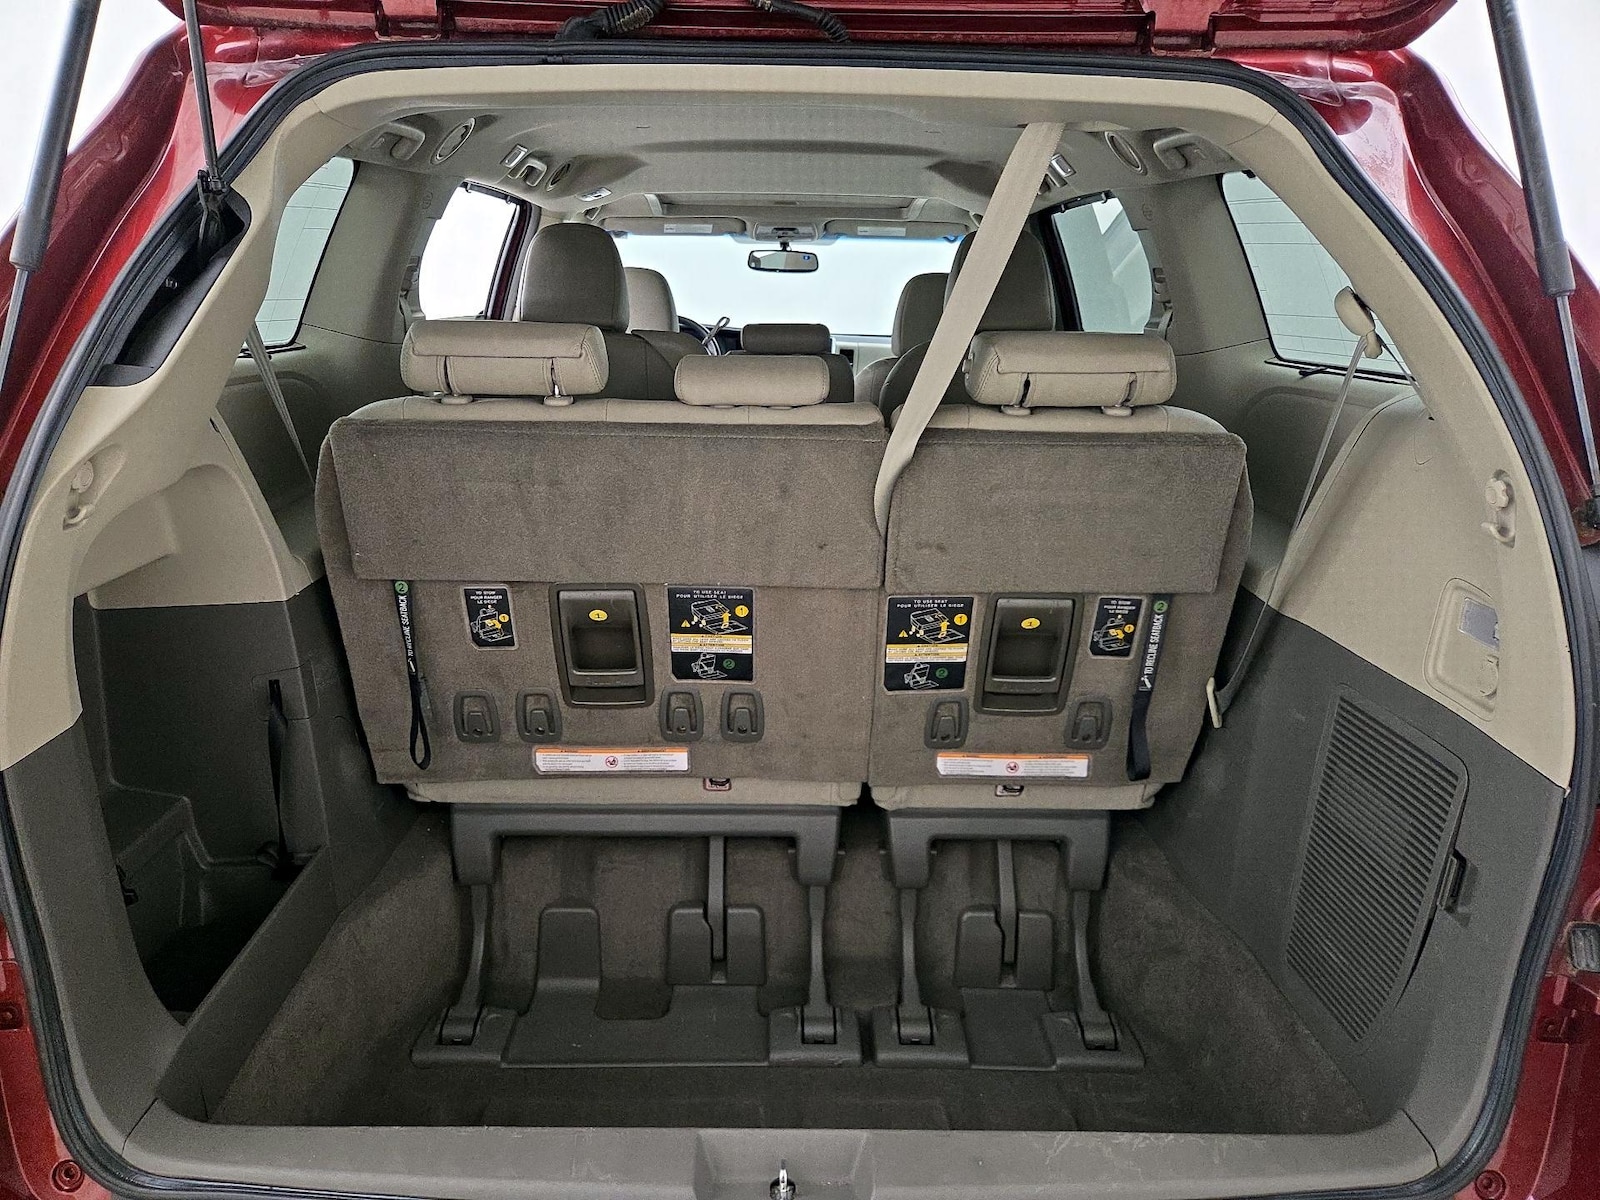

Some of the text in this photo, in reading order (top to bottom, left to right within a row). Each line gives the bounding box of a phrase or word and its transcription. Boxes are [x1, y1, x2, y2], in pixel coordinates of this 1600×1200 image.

[397, 594, 410, 626] SEATBACK
[402, 625, 413, 650] RECLINE
[1144, 614, 1164, 675] TO RECLINE SEATBACK
